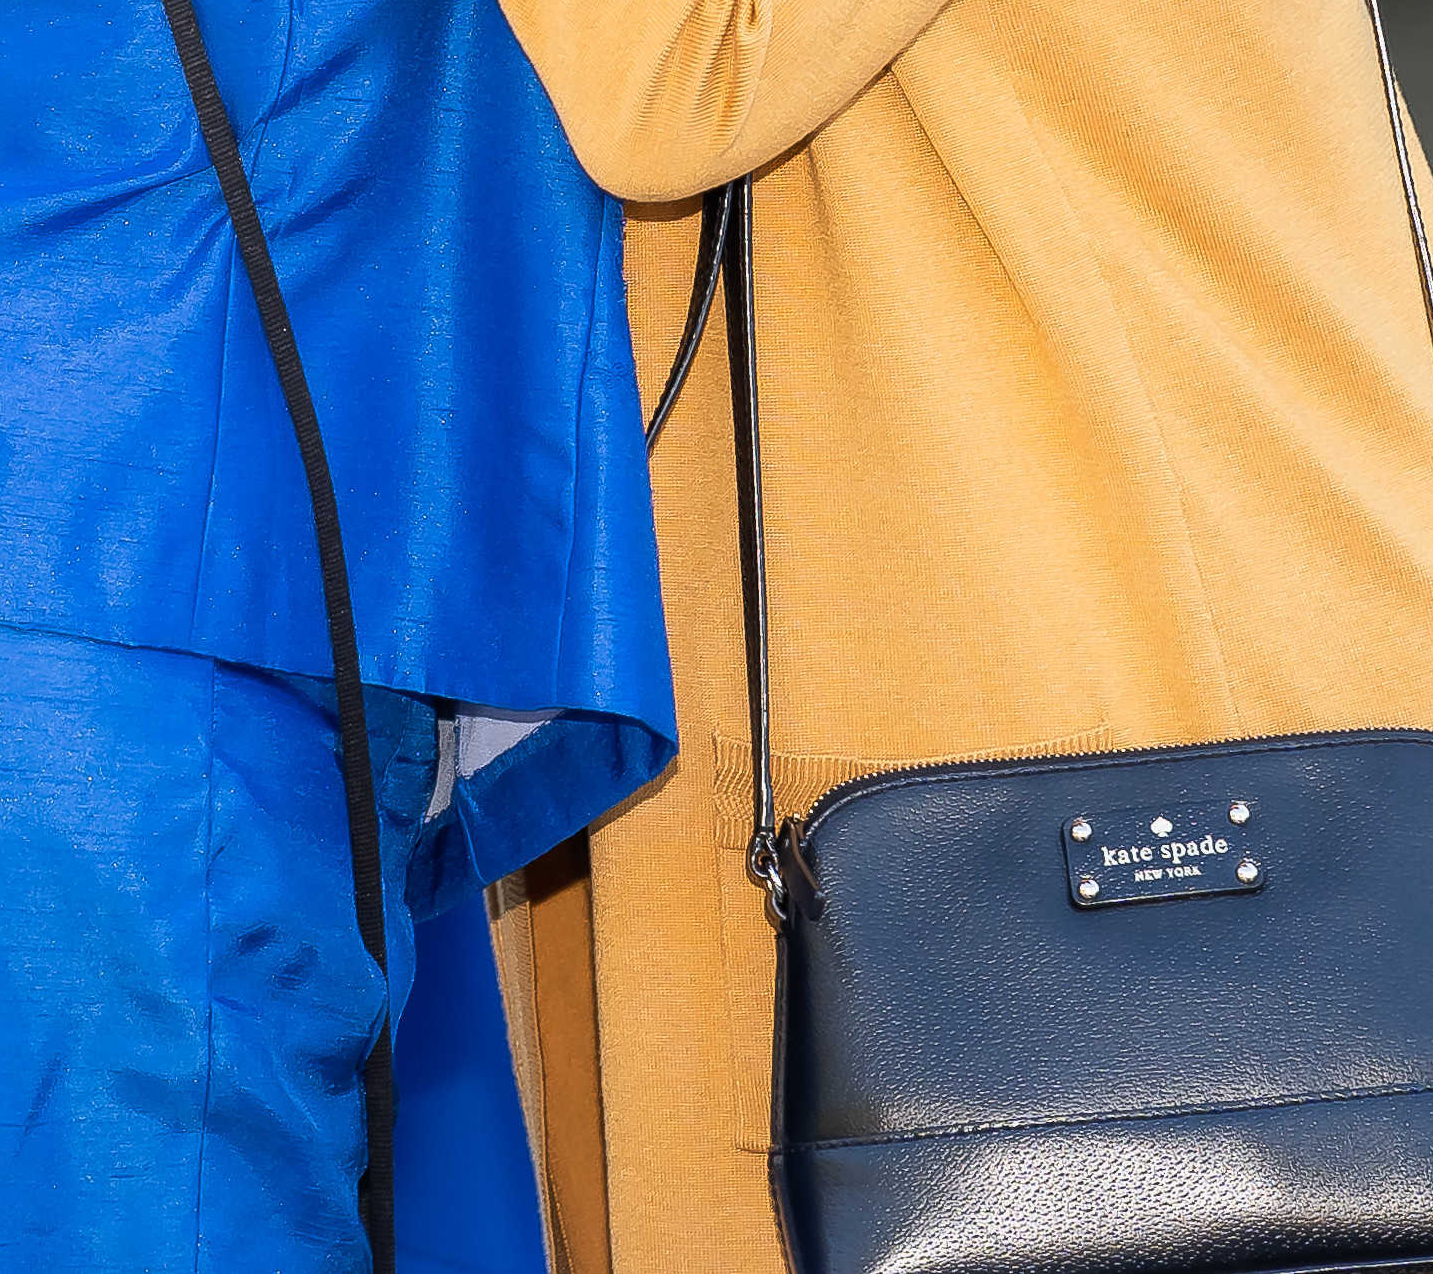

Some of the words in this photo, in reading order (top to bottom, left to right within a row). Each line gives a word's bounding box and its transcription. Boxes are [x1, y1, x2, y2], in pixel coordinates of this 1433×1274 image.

[1101, 845, 1153, 867] kate
[1160, 835, 1229, 864] spade
[1134, 868, 1163, 882] NEW
[1166, 865, 1202, 880] YORK
